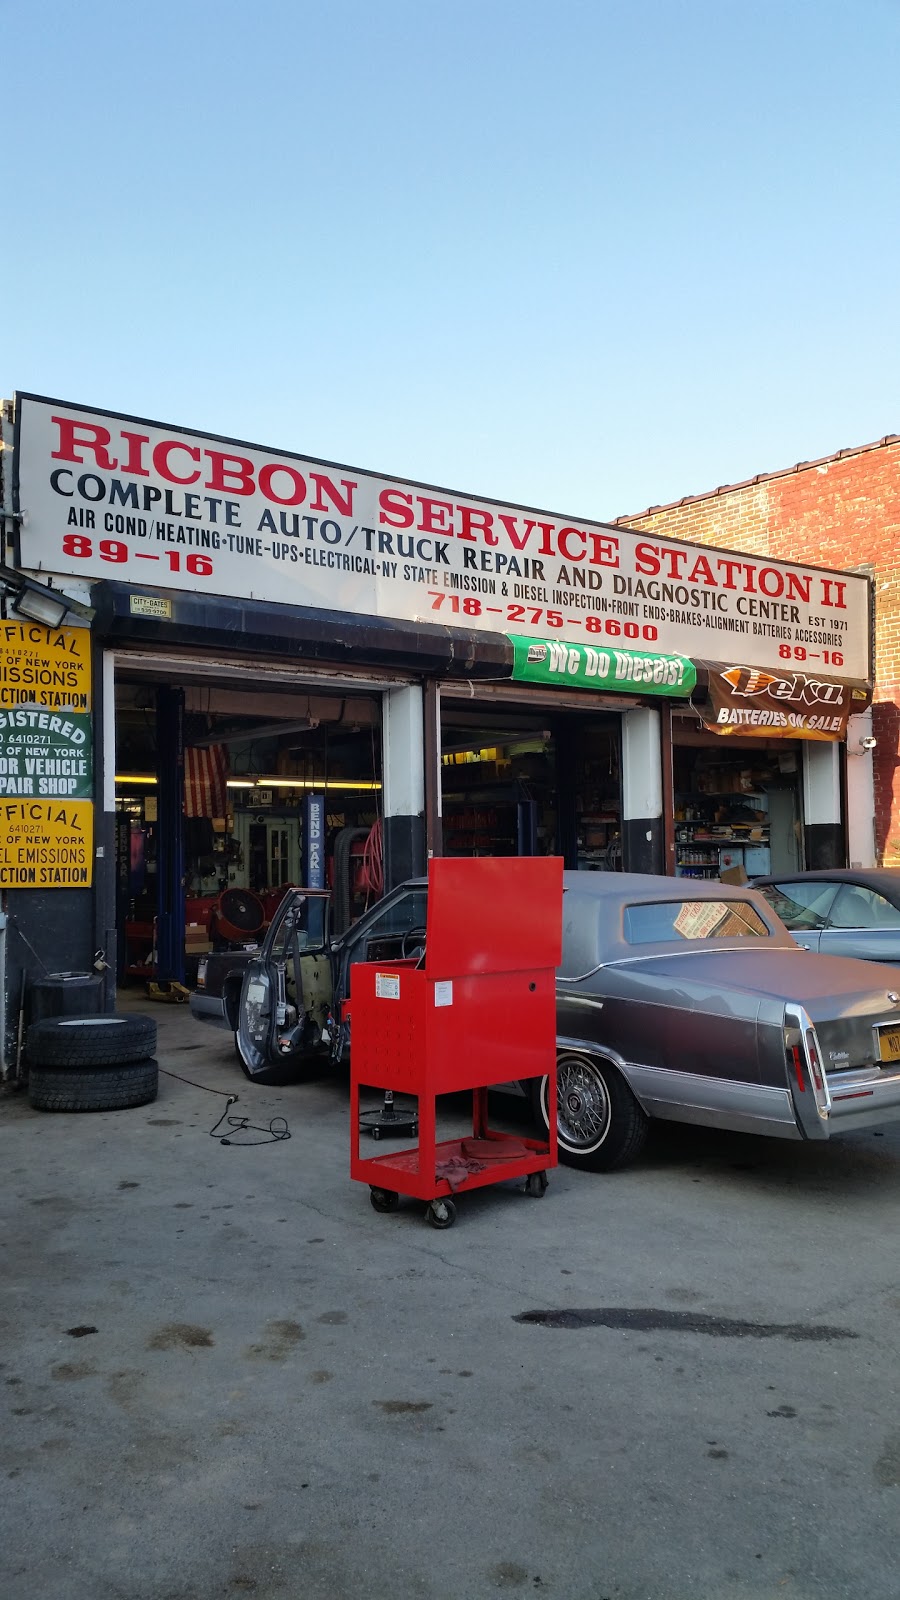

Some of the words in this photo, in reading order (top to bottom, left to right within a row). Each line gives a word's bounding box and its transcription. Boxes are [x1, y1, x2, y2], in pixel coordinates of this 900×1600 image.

[51, 416, 357, 517] RICBON
[379, 489, 619, 568] SERVICE
[635, 543, 812, 603] STATION
[820, 579, 847, 609] II
[50, 469, 242, 527] COMPLETE
[257, 509, 450, 565] AUTO/TRUCK
[463, 547, 546, 581] REPAIR
[557, 565, 603, 590] AND
[613, 574, 728, 613] DIAGNOSTIC
[736, 597, 800, 624] CENTER
[808, 616, 826, 627] EST
[830, 619, 848, 631] 1971
[62, 534, 213, 576] 89-16
[67, 506, 96, 529] AIR
[403, 564, 439, 586] STATE
[443, 571, 496, 595] EMISSION
[501, 581, 509, 597] &
[513, 583, 549, 603] DIESEL
[753, 622, 792, 640] BATTERIES
[795, 628, 843, 647] ACCESSORIES
[427, 590, 658, 641] 718-275-8600
[0, 626, 80, 657] FICIAL
[6, 656, 21, 665] OF
[26, 658, 50, 668] NEW
[55, 661, 84, 671] YORK
[546, 642, 581, 675] We
[584, 647, 610, 678] Do
[613, 651, 684, 686] Diesels!
[779, 643, 844, 667] 89-16
[0, 666, 78, 687] ISSIONS
[720, 666, 843, 706] Deka
[40, 691, 87, 708] STATION
[716, 708, 788, 727] BATTERIES
[788, 713, 808, 728] ON
[807, 715, 843, 732] SALE!
[8, 734, 51, 744] 6410271
[6, 747, 22, 755] OF
[25, 747, 49, 756] NEW
[53, 749, 84, 758] YORK
[25, 758, 87, 776] VEHICLE
[38, 777, 77, 795] SHOP
[0, 804, 82, 831] FICIAL
[9, 824, 44, 833] 6410271
[310, 803, 320, 839] BEND
[6, 835, 21, 844] OF
[26, 836, 50, 844] NEW
[55, 836, 85, 845] YORK
[18, 848, 86, 864] EMISSIONS
[310, 843, 320, 869] PAK
[40, 867, 88, 883] STATION
